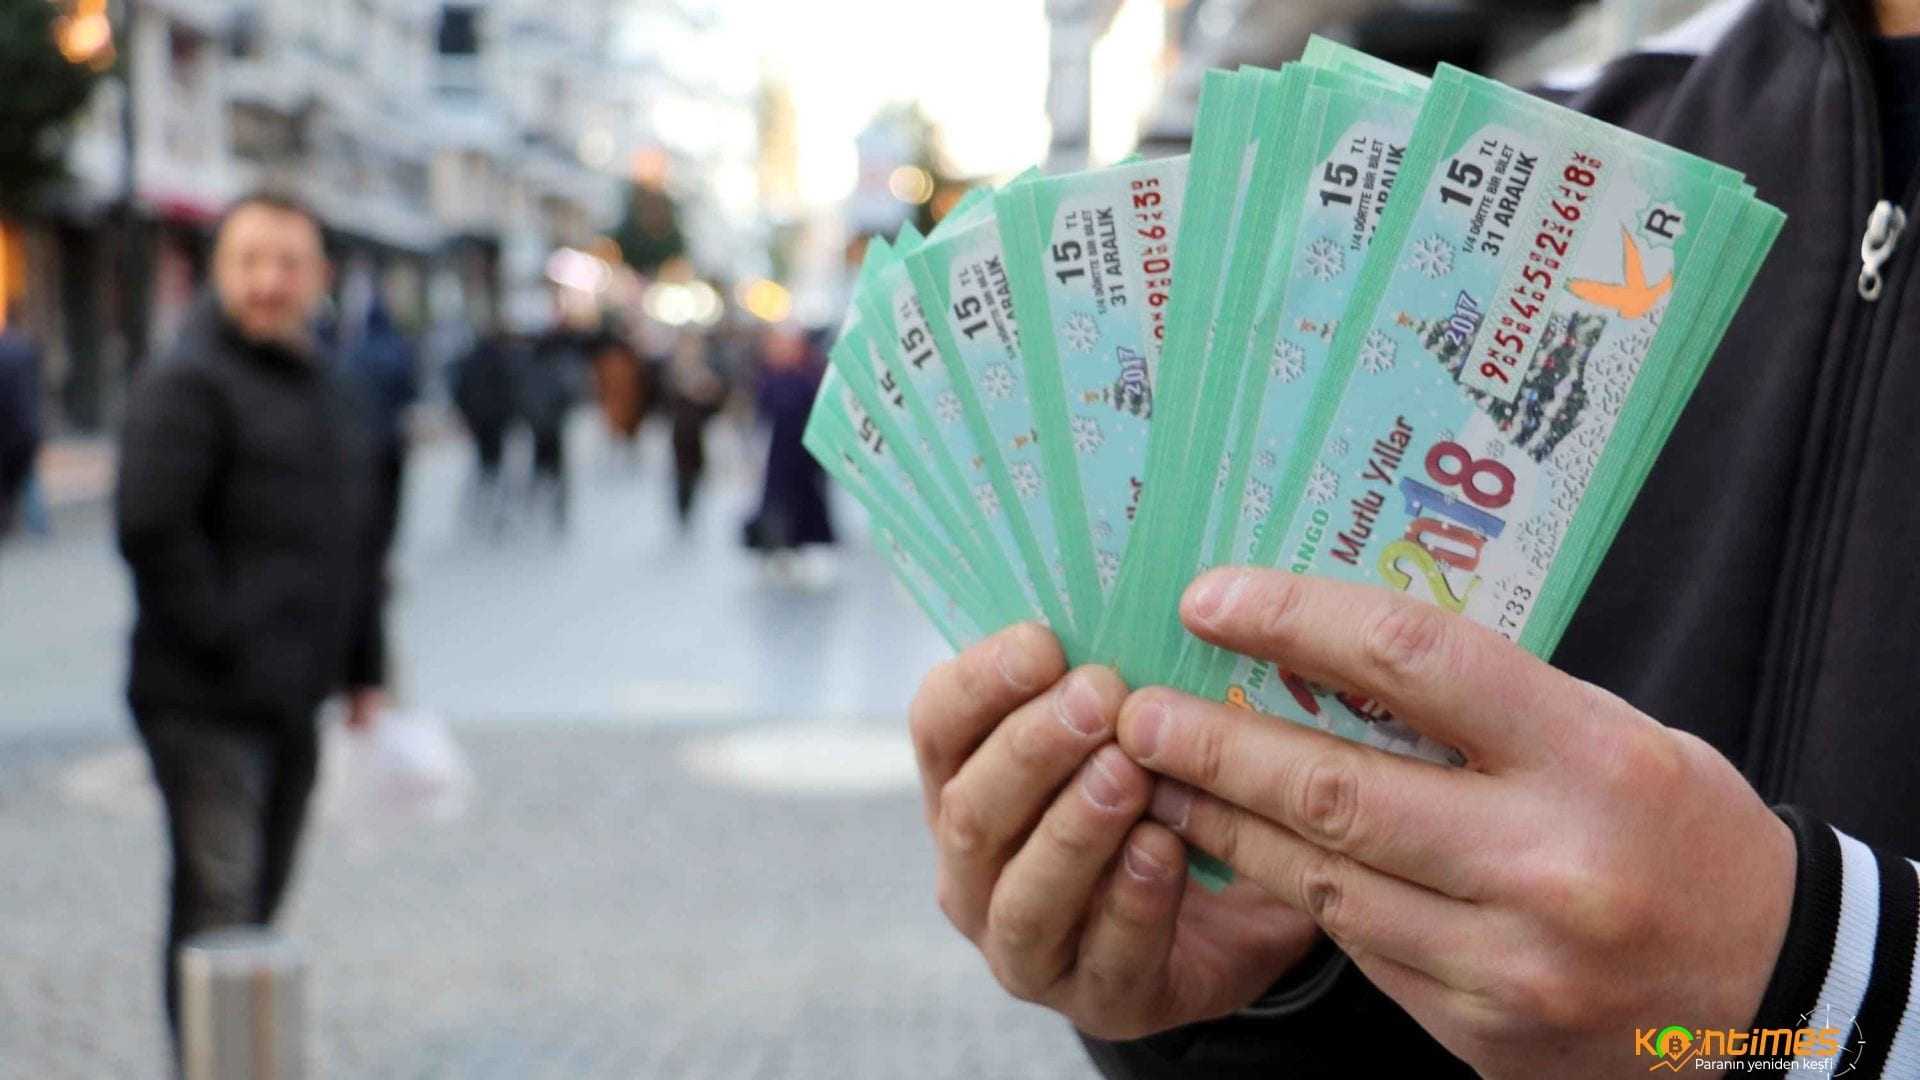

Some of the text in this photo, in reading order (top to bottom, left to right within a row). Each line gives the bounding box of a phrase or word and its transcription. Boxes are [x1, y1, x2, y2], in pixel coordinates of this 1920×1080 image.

[1320, 137, 1367, 207] 15 TL
[1440, 139, 1498, 207] 15 TL
[1481, 152, 1538, 256] 31 ARALIK
[1052, 210, 1085, 284] 15 TL
[1095, 207, 1127, 306] 31 ARALIK
[1462, 233, 1477, 253] 1/4
[1645, 207, 1682, 239] R
[1480, 164, 1596, 384] 9545268
[902, 327, 933, 369] 15
[953, 296, 988, 340] 15
[1445, 289, 1485, 346] 2017
[1116, 346, 1146, 396] 2017
[1329, 415, 1414, 565] Mutlu Yıllar
[1376, 441, 1516, 614] 2018
